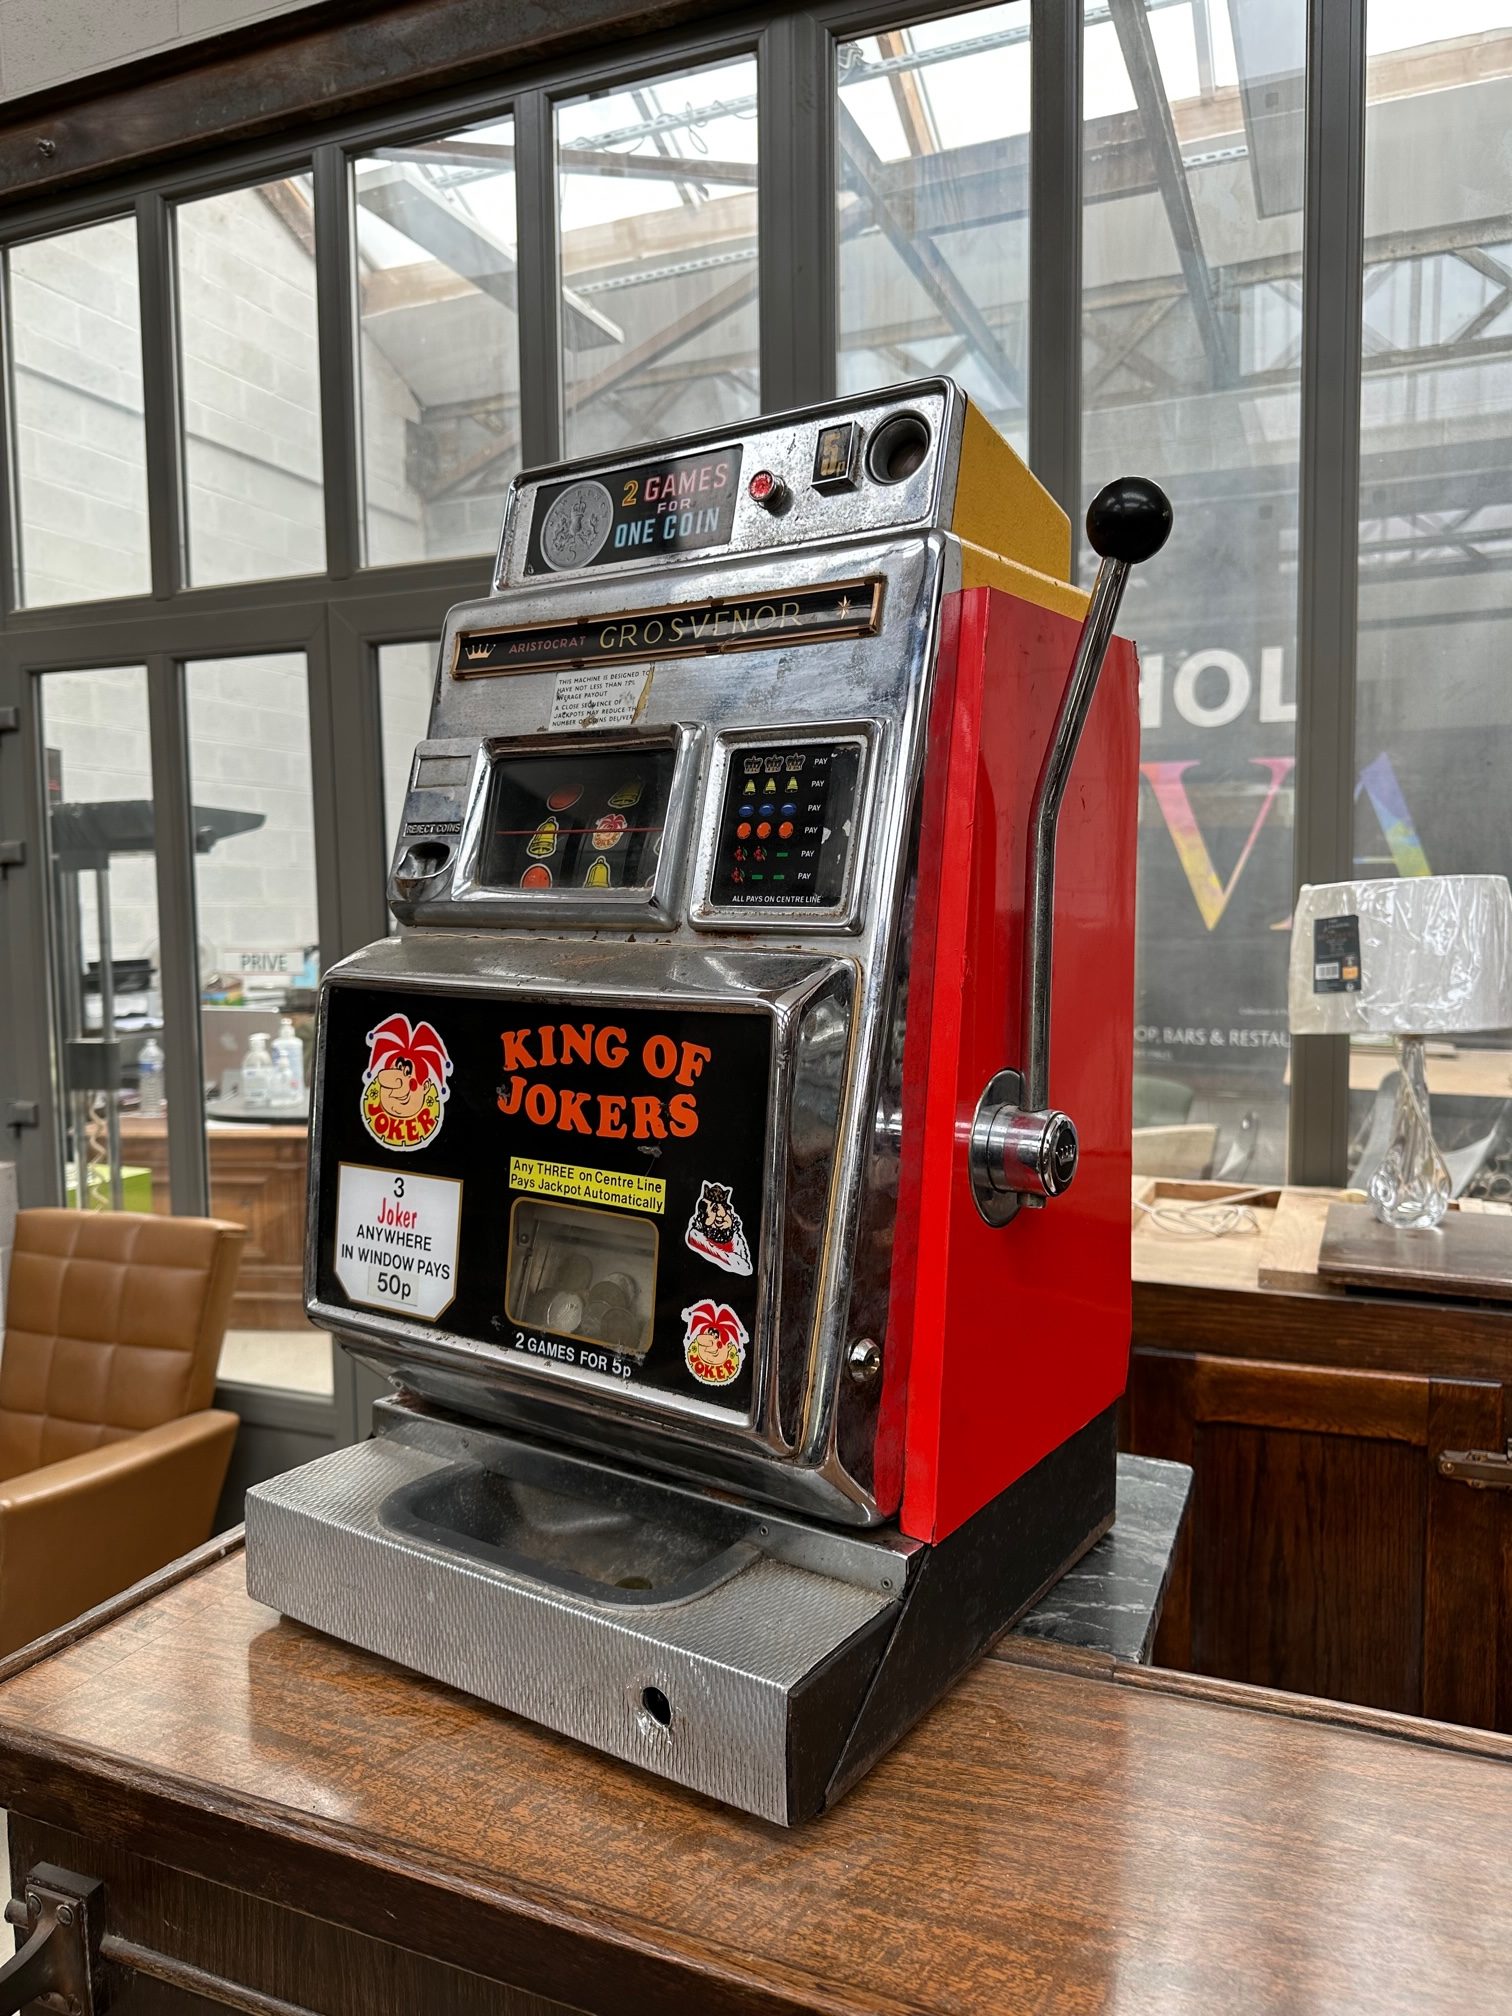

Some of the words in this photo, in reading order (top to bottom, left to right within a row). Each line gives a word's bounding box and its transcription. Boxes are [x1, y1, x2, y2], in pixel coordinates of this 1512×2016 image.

[622, 480, 639, 507] 2
[644, 463, 728, 501] GAMES
[657, 497, 691, 514] FOR
[614, 519, 655, 549] ONE
[662, 507, 720, 541] COIN
[508, 635, 586, 655] ARISTOCRAT
[600, 602, 802, 649] GROSVENOR
[573, 675, 601, 684] MACHINE
[610, 671, 640, 680] DESIGNED
[584, 690, 608, 698] PAYOUT
[554, 711, 585, 719] JACKPOTS
[601, 706, 625, 714] REDUCE
[561, 703, 579, 711] CLOSE
[552, 719, 576, 727] NUMBER
[814, 758, 828, 766] PAY
[811, 780, 825, 788] PAY
[807, 804, 822, 812] PAY
[406, 823, 436, 834] REJECT
[436, 823, 461, 833] COINS
[801, 850, 815, 858] PAY
[732, 895, 745, 903] ALL
[745, 895, 763, 903] PAYS
[764, 895, 775, 903] ON
[776, 895, 805, 903] CENTRE
[805, 895, 822, 904] LINE
[240, 953, 289, 971] PRIVE
[1163, 1026, 1207, 1046] BARS
[1209, 1028, 1225, 1047] &
[500, 1023, 629, 1071] KING
[642, 1034, 712, 1087] OF
[497, 1075, 699, 1139] JOKERS
[368, 1103, 436, 1141] JOKER
[513, 1160, 534, 1175] Any
[537, 1162, 575, 1180] THREE
[579, 1171, 592, 1182] on
[594, 1171, 634, 1189] Centre
[637, 1177, 662, 1193] Line
[393, 1177, 405, 1198] 3
[510, 1174, 535, 1188] Pays
[538, 1178, 581, 1196] Jackpot
[583, 1185, 663, 1213] Automatically
[377, 1197, 418, 1230] Joker
[356, 1224, 432, 1252] ANYWHERE
[341, 1243, 354, 1260] IN
[358, 1246, 415, 1272] WINDOW
[417, 1259, 450, 1280] PAYS
[377, 1271, 411, 1300] 50p
[515, 1332, 525, 1349] 2
[527, 1337, 575, 1362] GAMES
[580, 1350, 608, 1371] FOR
[611, 1357, 632, 1379] 5p
[690, 1355, 736, 1379] JOKER
